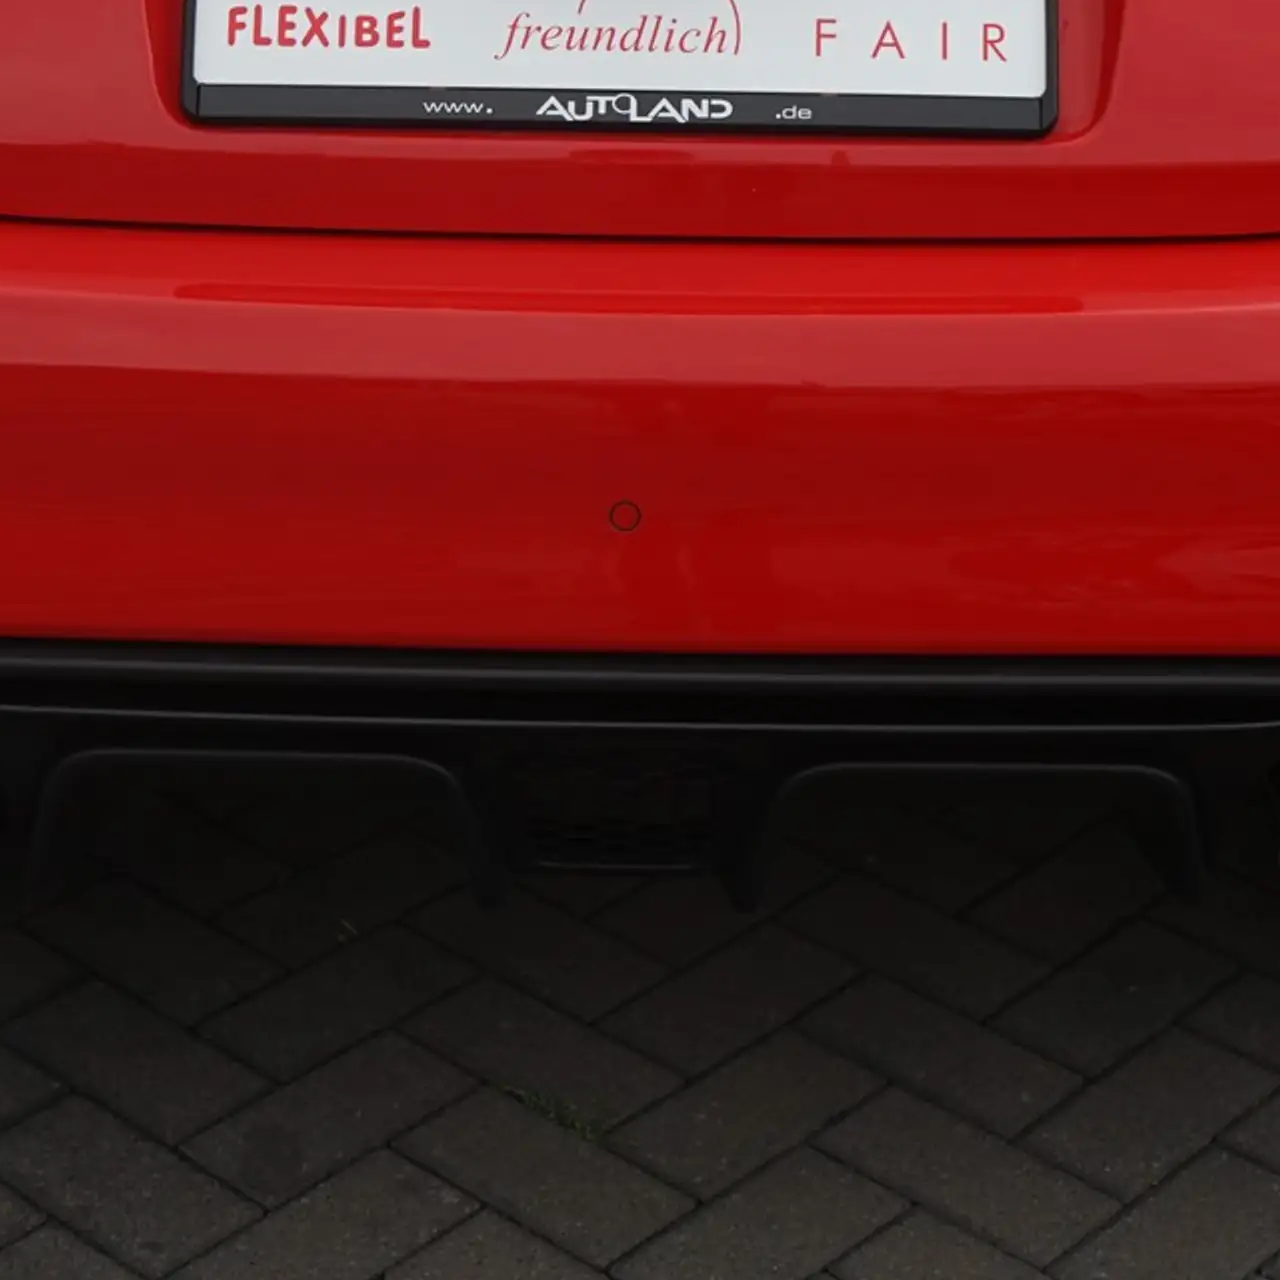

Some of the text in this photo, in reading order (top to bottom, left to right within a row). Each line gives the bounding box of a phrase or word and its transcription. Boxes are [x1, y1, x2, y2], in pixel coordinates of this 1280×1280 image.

[226, 3, 1008, 62] FLEXIBEL freundlich FAIR
[422, 92, 813, 122] www. AUTOLAND .de
